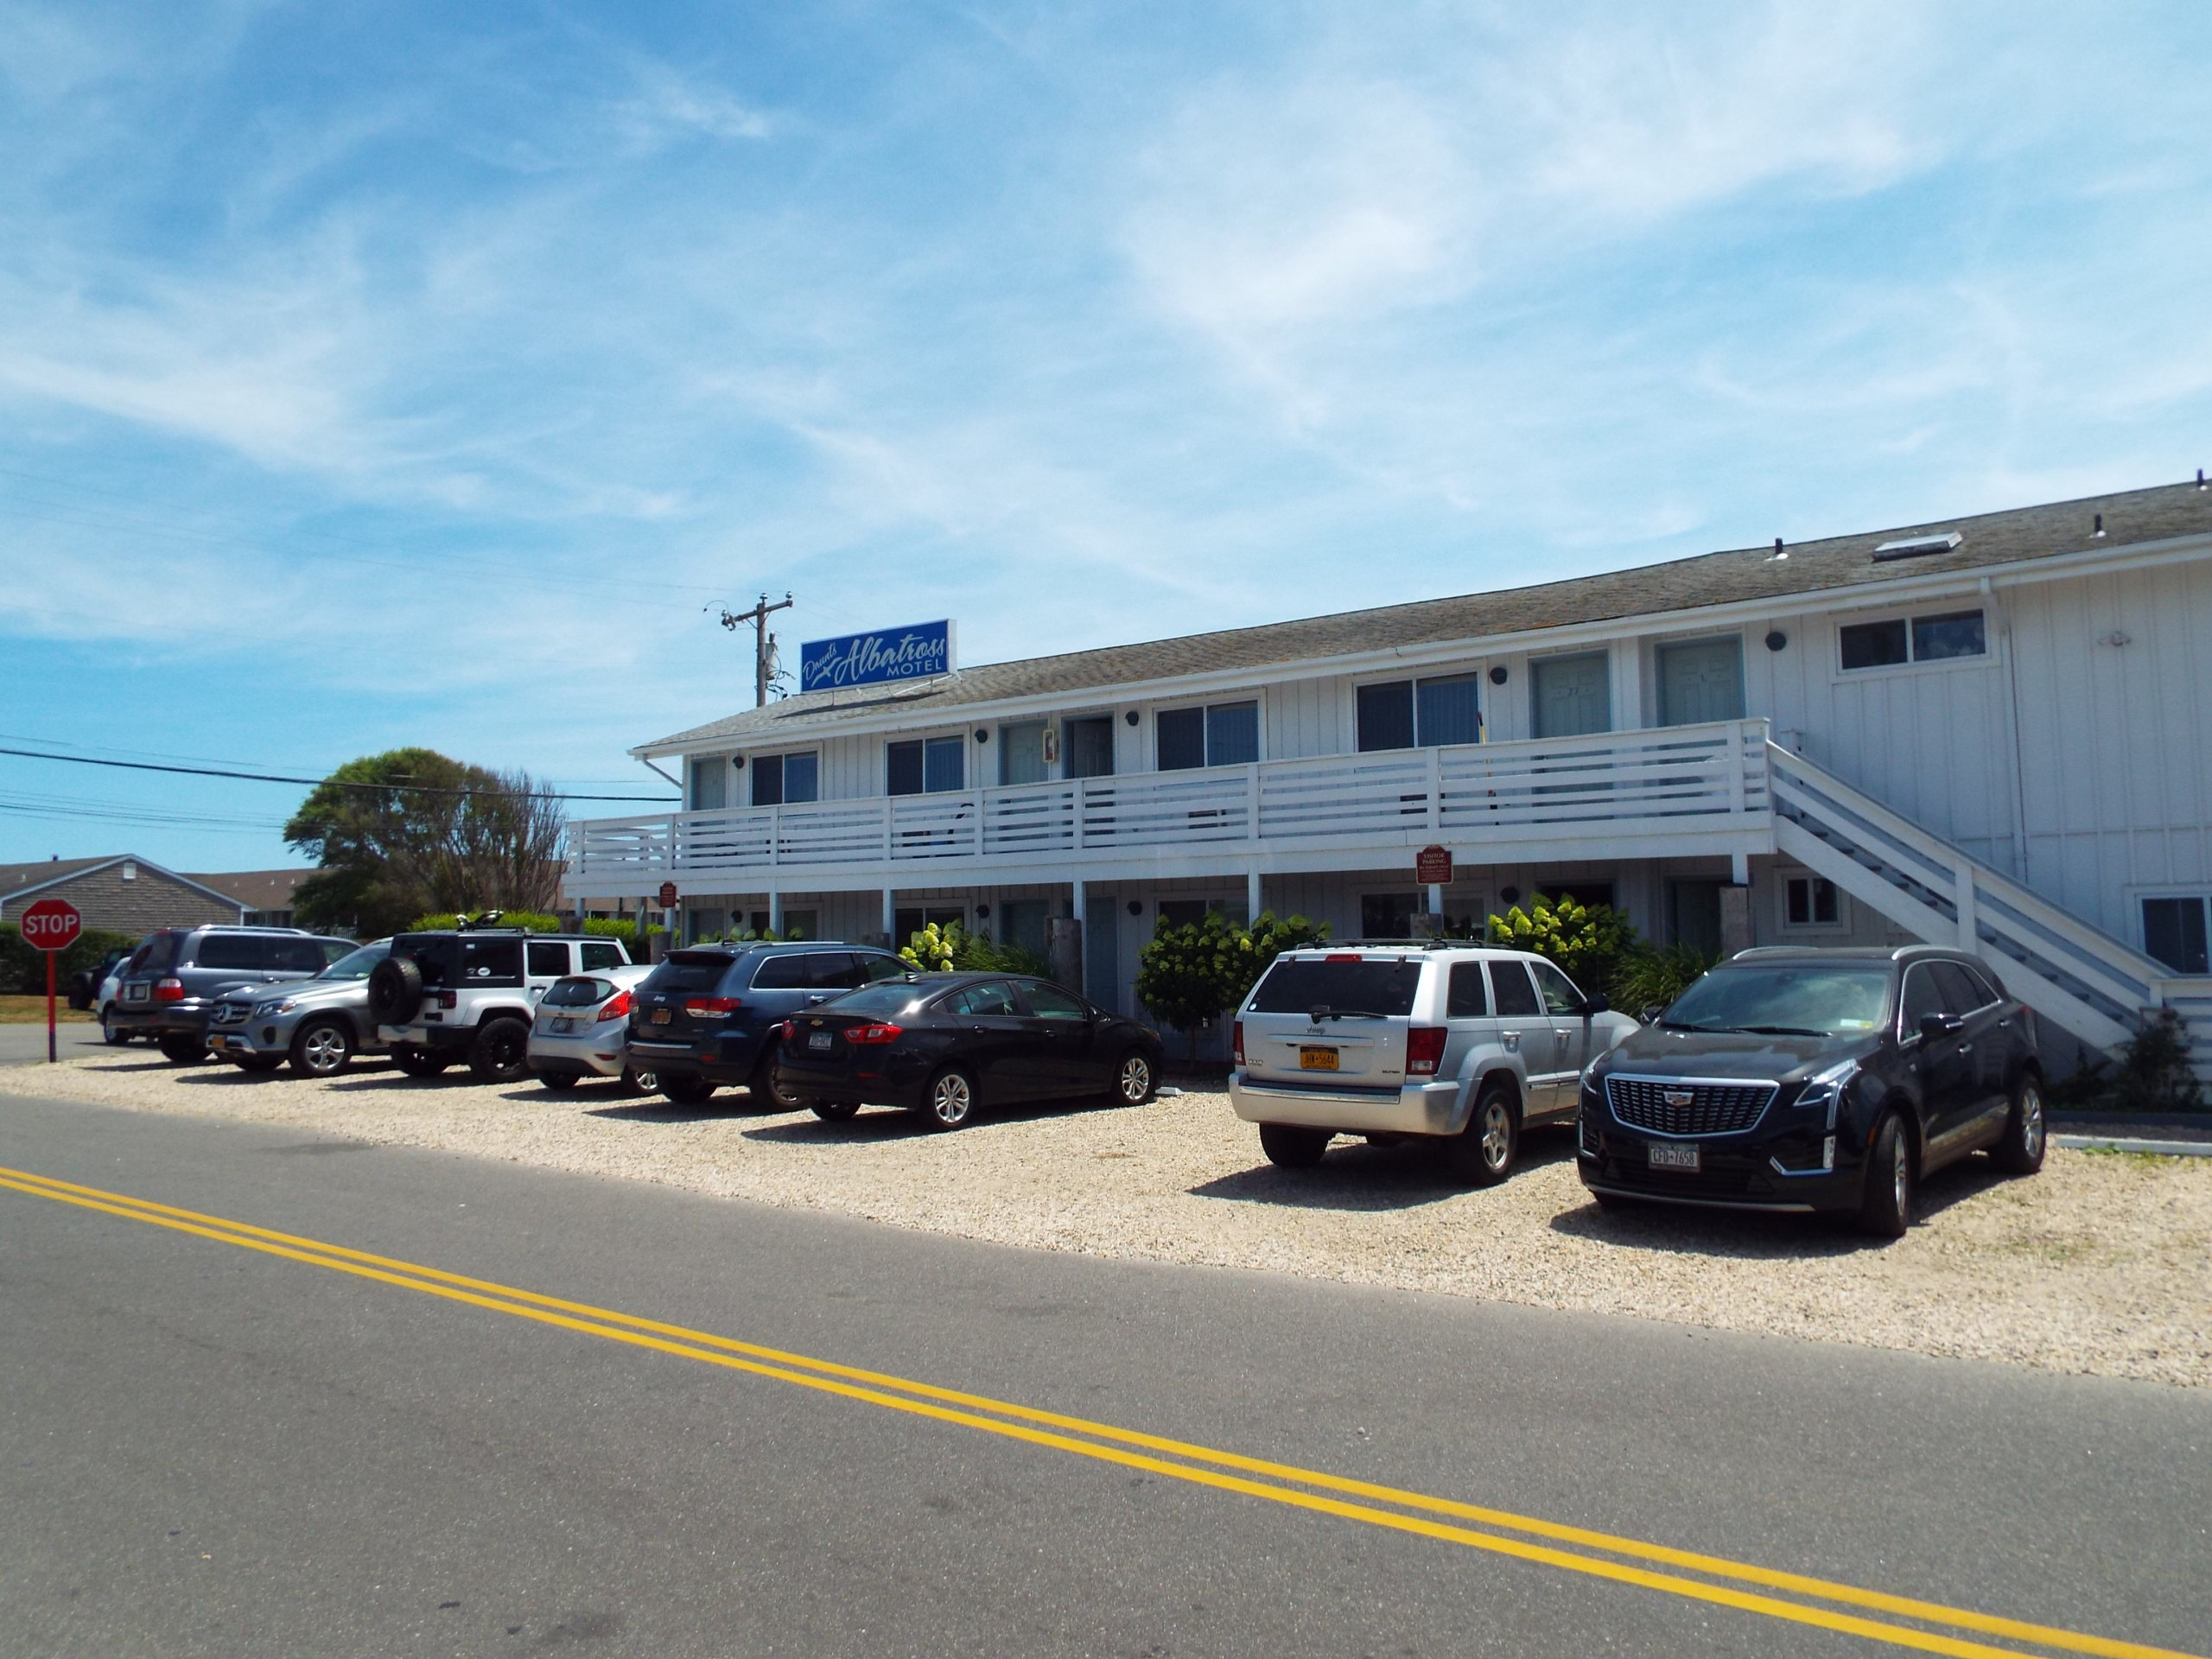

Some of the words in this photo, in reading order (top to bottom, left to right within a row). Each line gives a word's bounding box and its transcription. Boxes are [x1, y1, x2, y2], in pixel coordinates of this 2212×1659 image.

[834, 633, 945, 684] Albatross
[887, 658, 943, 677] MOTEL
[25, 914, 78, 934] STOP
